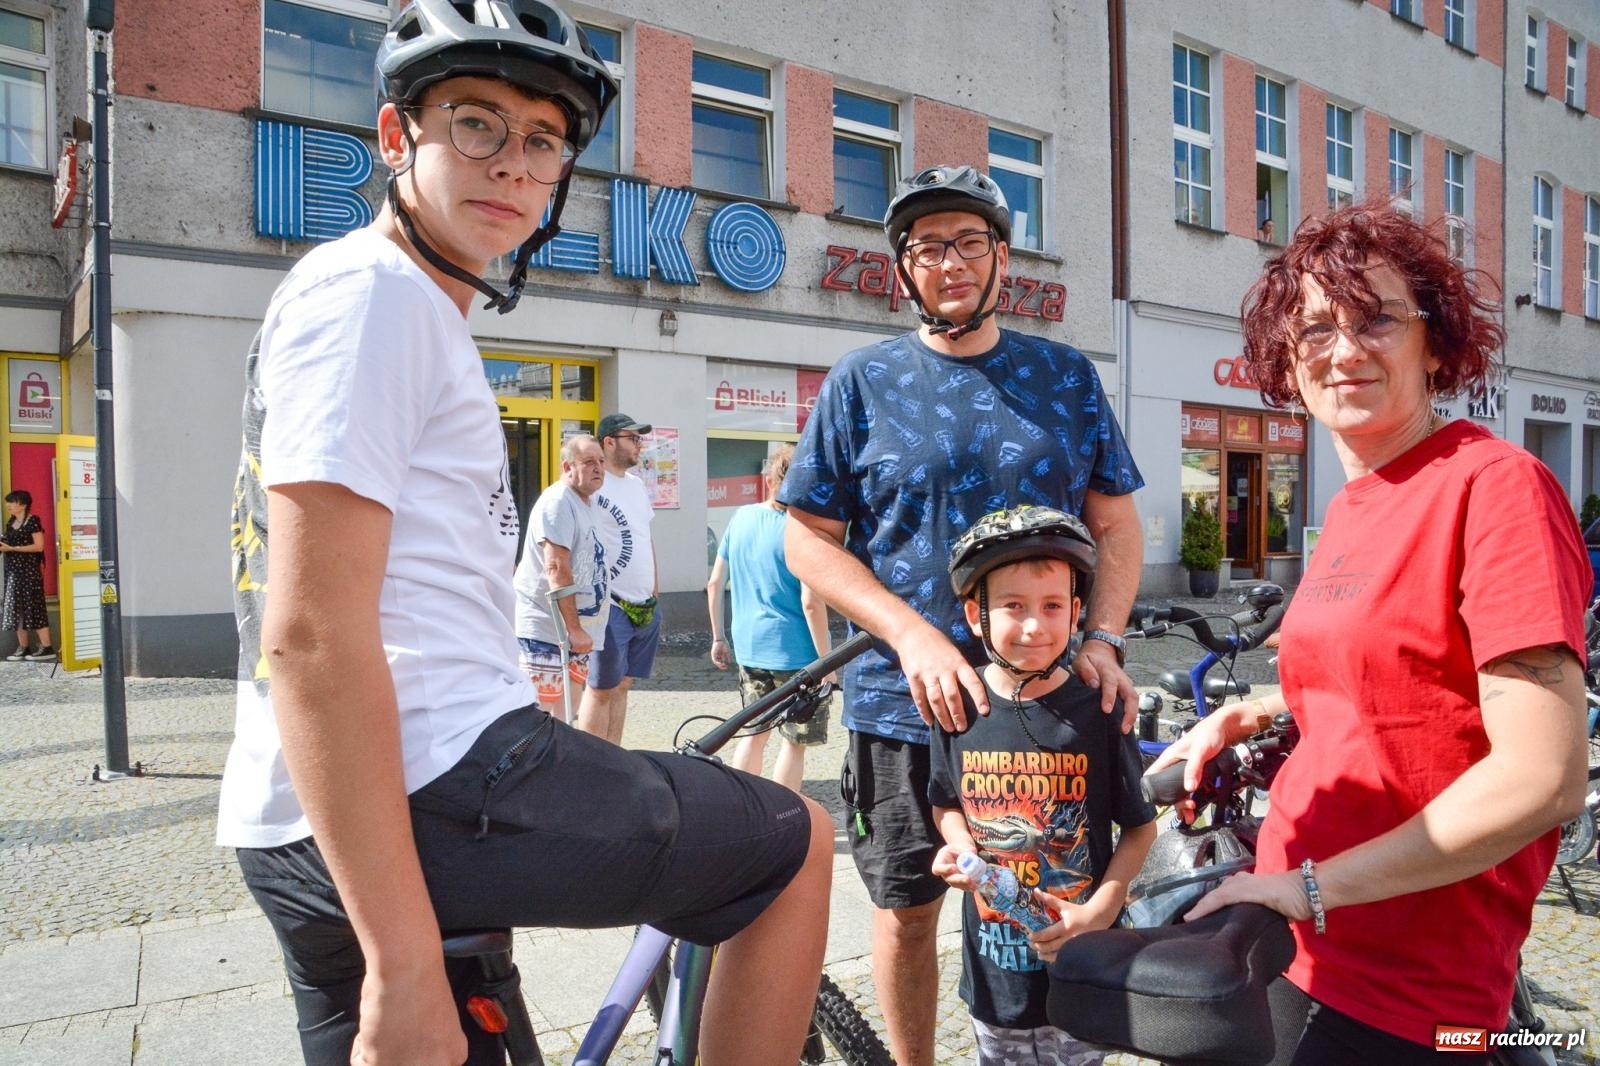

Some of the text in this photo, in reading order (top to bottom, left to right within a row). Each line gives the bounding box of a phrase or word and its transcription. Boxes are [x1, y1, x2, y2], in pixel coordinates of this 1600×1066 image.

[255, 118, 787, 293] BLKO
[821, 245, 1067, 322] zapsza
[736, 388, 787, 408] Bliski
[1531, 394, 1567, 414] BOLKO
[18, 408, 53, 419] Bliski
[609, 504, 628, 527] KEEP
[616, 529, 633, 569] MOVING
[962, 750, 1088, 775] BOMBARDIRO
[961, 774, 1087, 801] CROCODILO
[1007, 860, 1041, 887] VS
